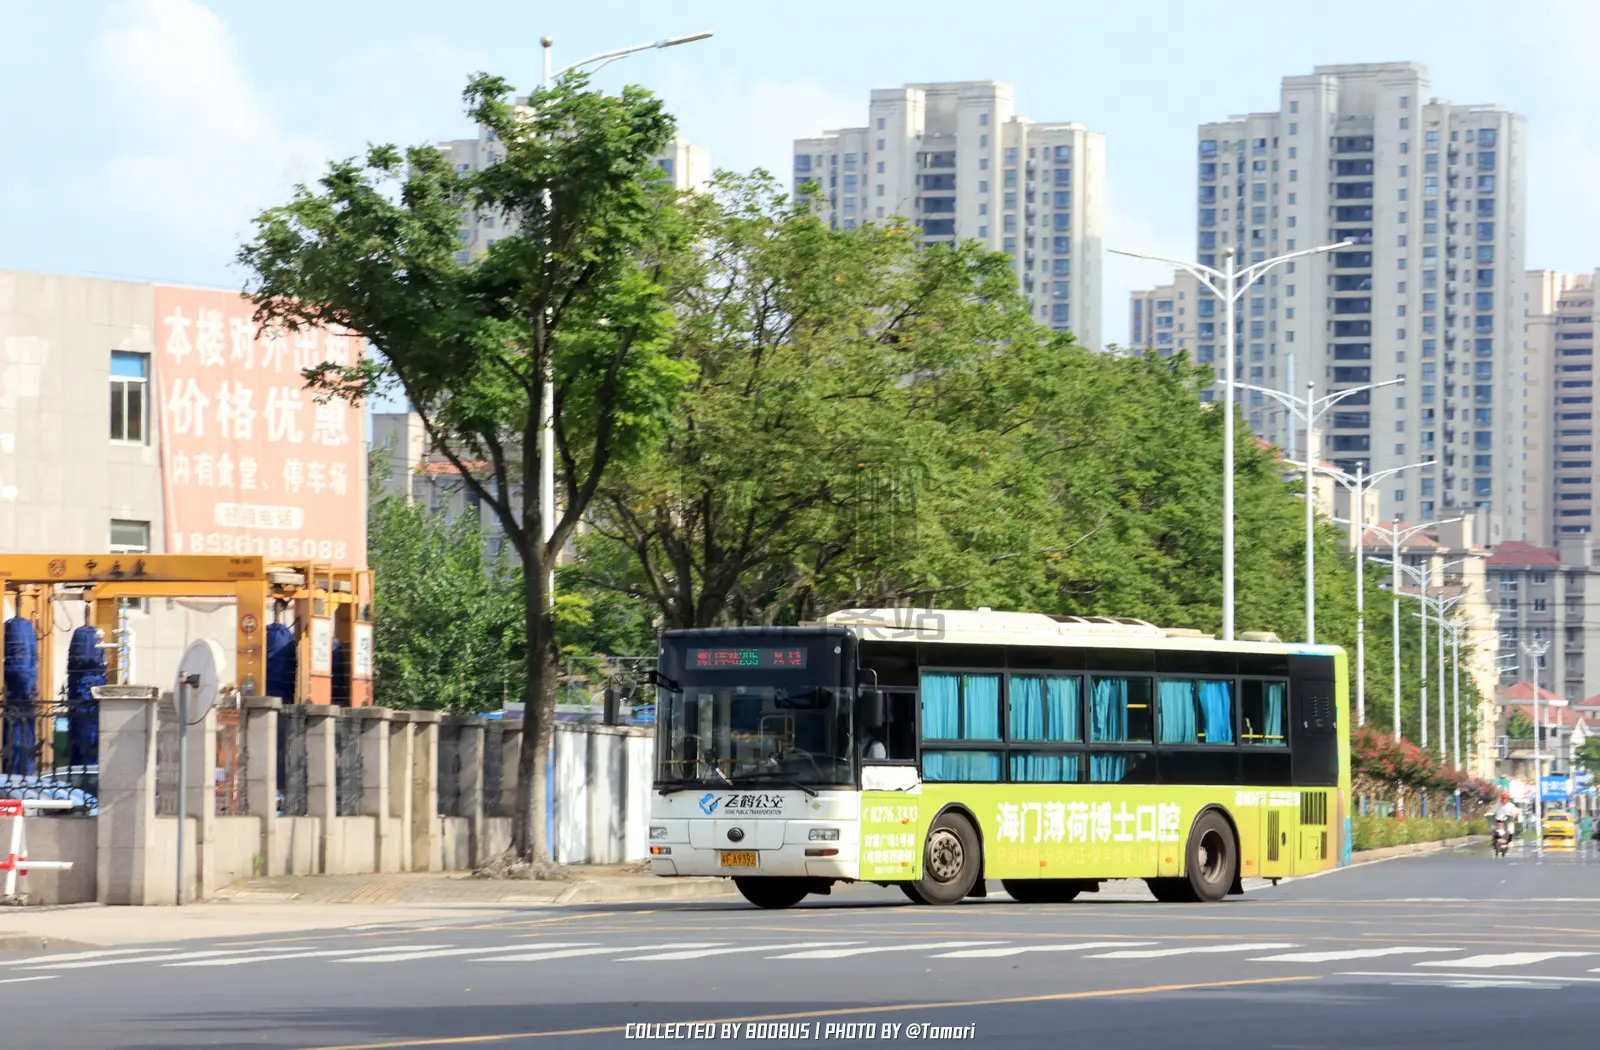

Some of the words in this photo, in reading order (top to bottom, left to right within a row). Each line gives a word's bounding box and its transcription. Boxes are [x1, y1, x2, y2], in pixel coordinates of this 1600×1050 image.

[168, 378, 350, 446] 价格优惠
[724, 794, 785, 809] 飞鹤公交
[996, 801, 1181, 843] 海门薄荷博士口腔
